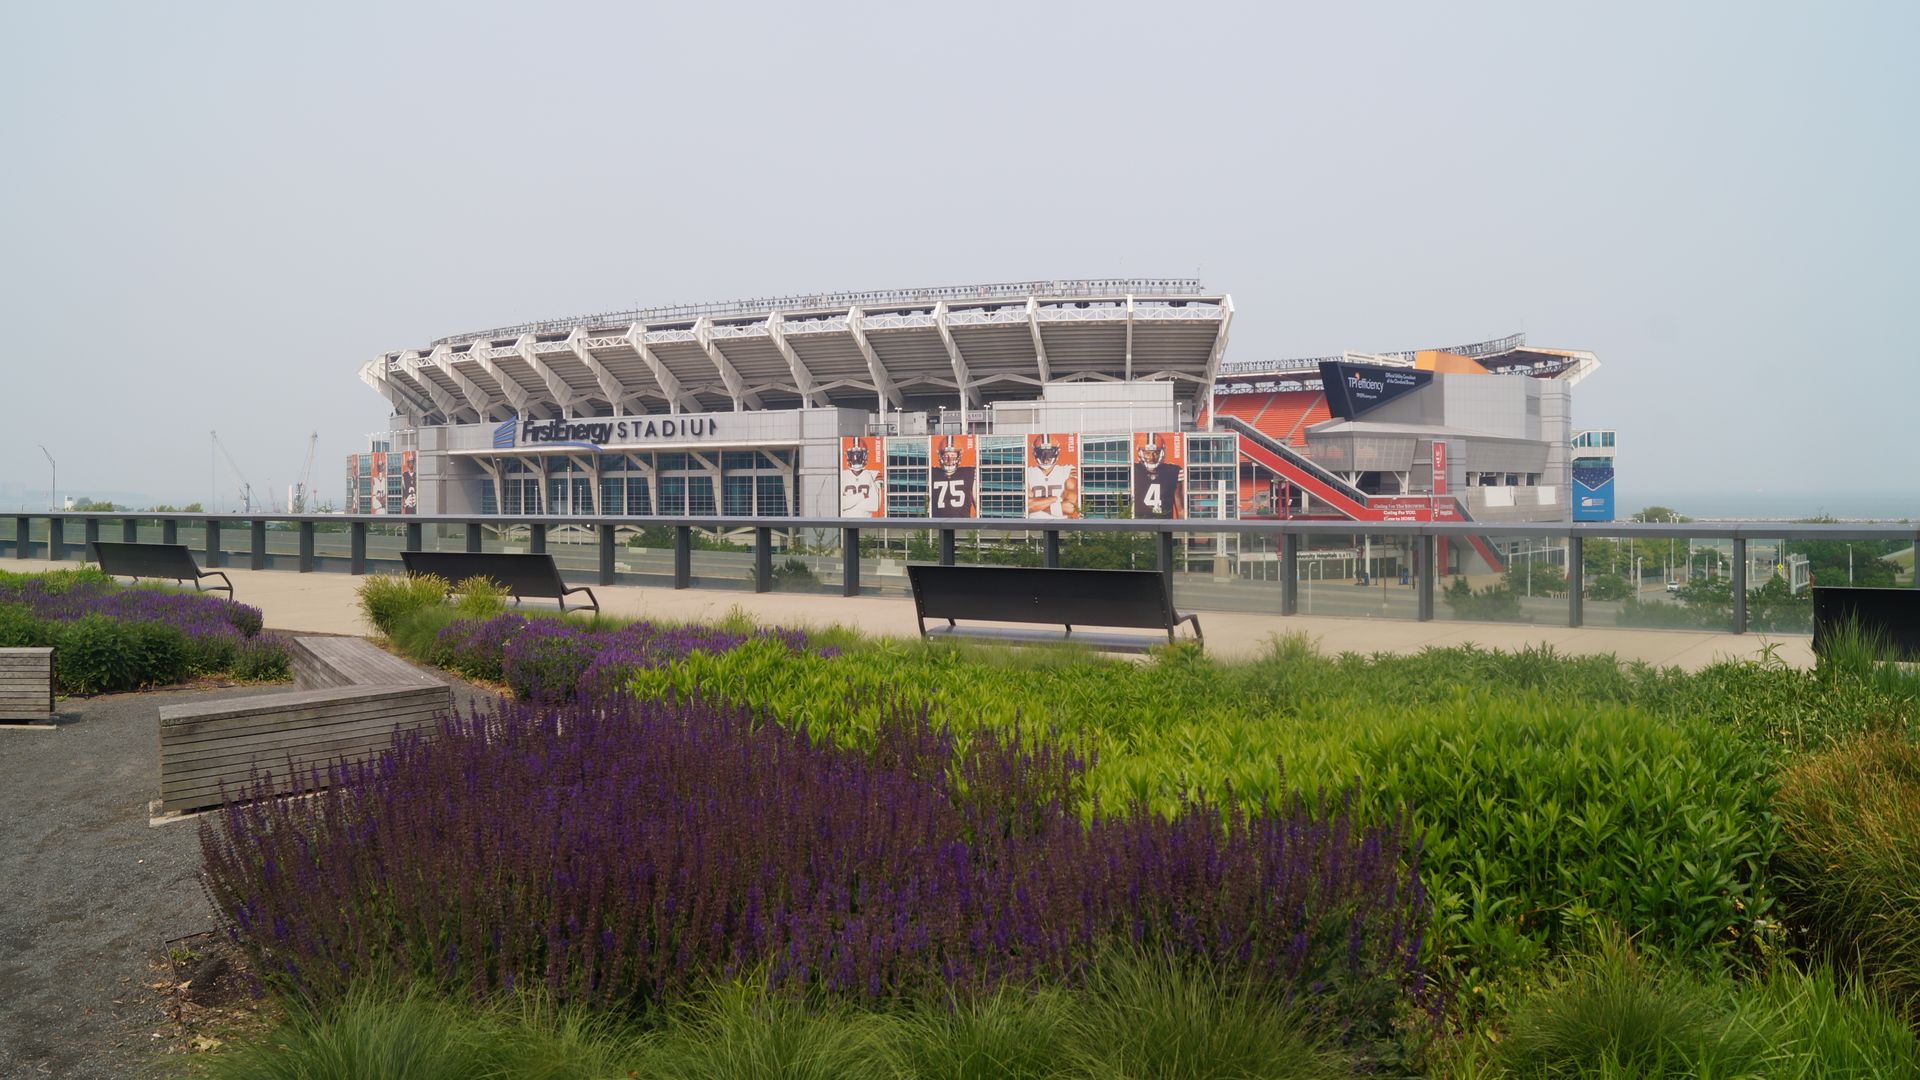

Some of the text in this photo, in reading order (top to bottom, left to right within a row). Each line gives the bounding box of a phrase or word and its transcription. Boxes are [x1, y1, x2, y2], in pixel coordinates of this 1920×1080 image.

[521, 418, 613, 444] FirstEnergy
[934, 480, 965, 509] 75
[1143, 483, 1163, 513] 4
